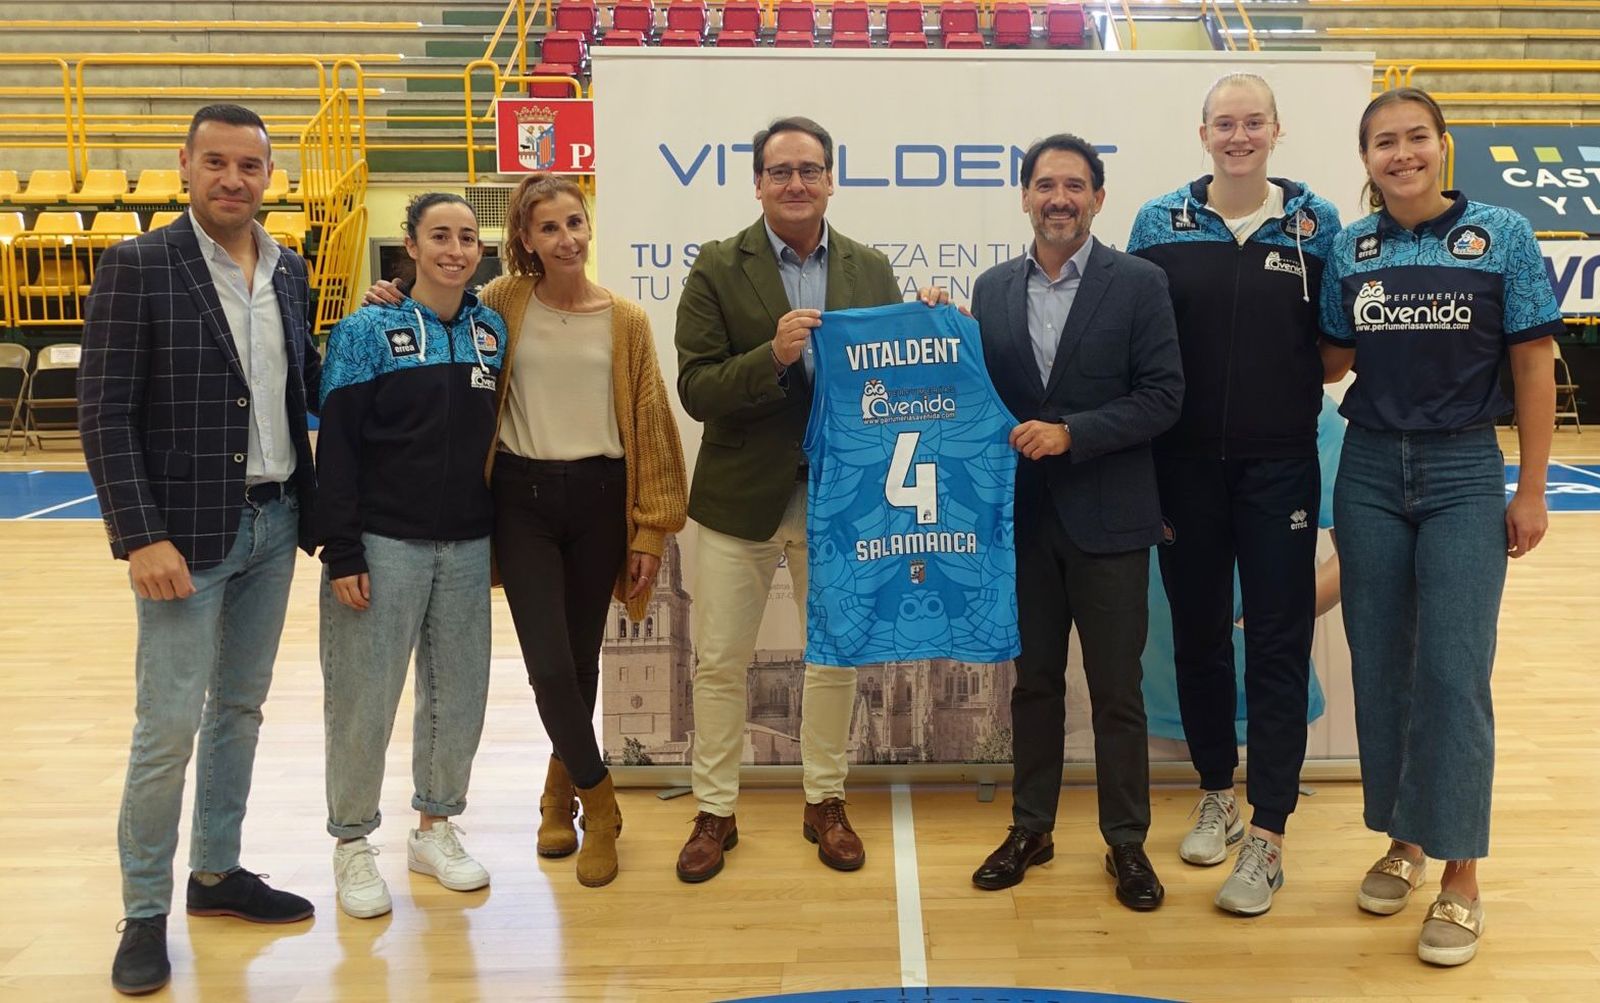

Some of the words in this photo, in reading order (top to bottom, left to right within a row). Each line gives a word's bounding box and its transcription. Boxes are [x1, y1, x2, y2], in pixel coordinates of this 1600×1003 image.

[630, 243, 672, 268] TU
[939, 243, 977, 268] EN
[630, 275, 670, 300] TU
[1386, 291, 1474, 301] PERFUMERÍAS
[845, 337, 961, 371] VITALDENT
[885, 431, 938, 525] 4
[855, 531, 977, 561] SALAMANCA
